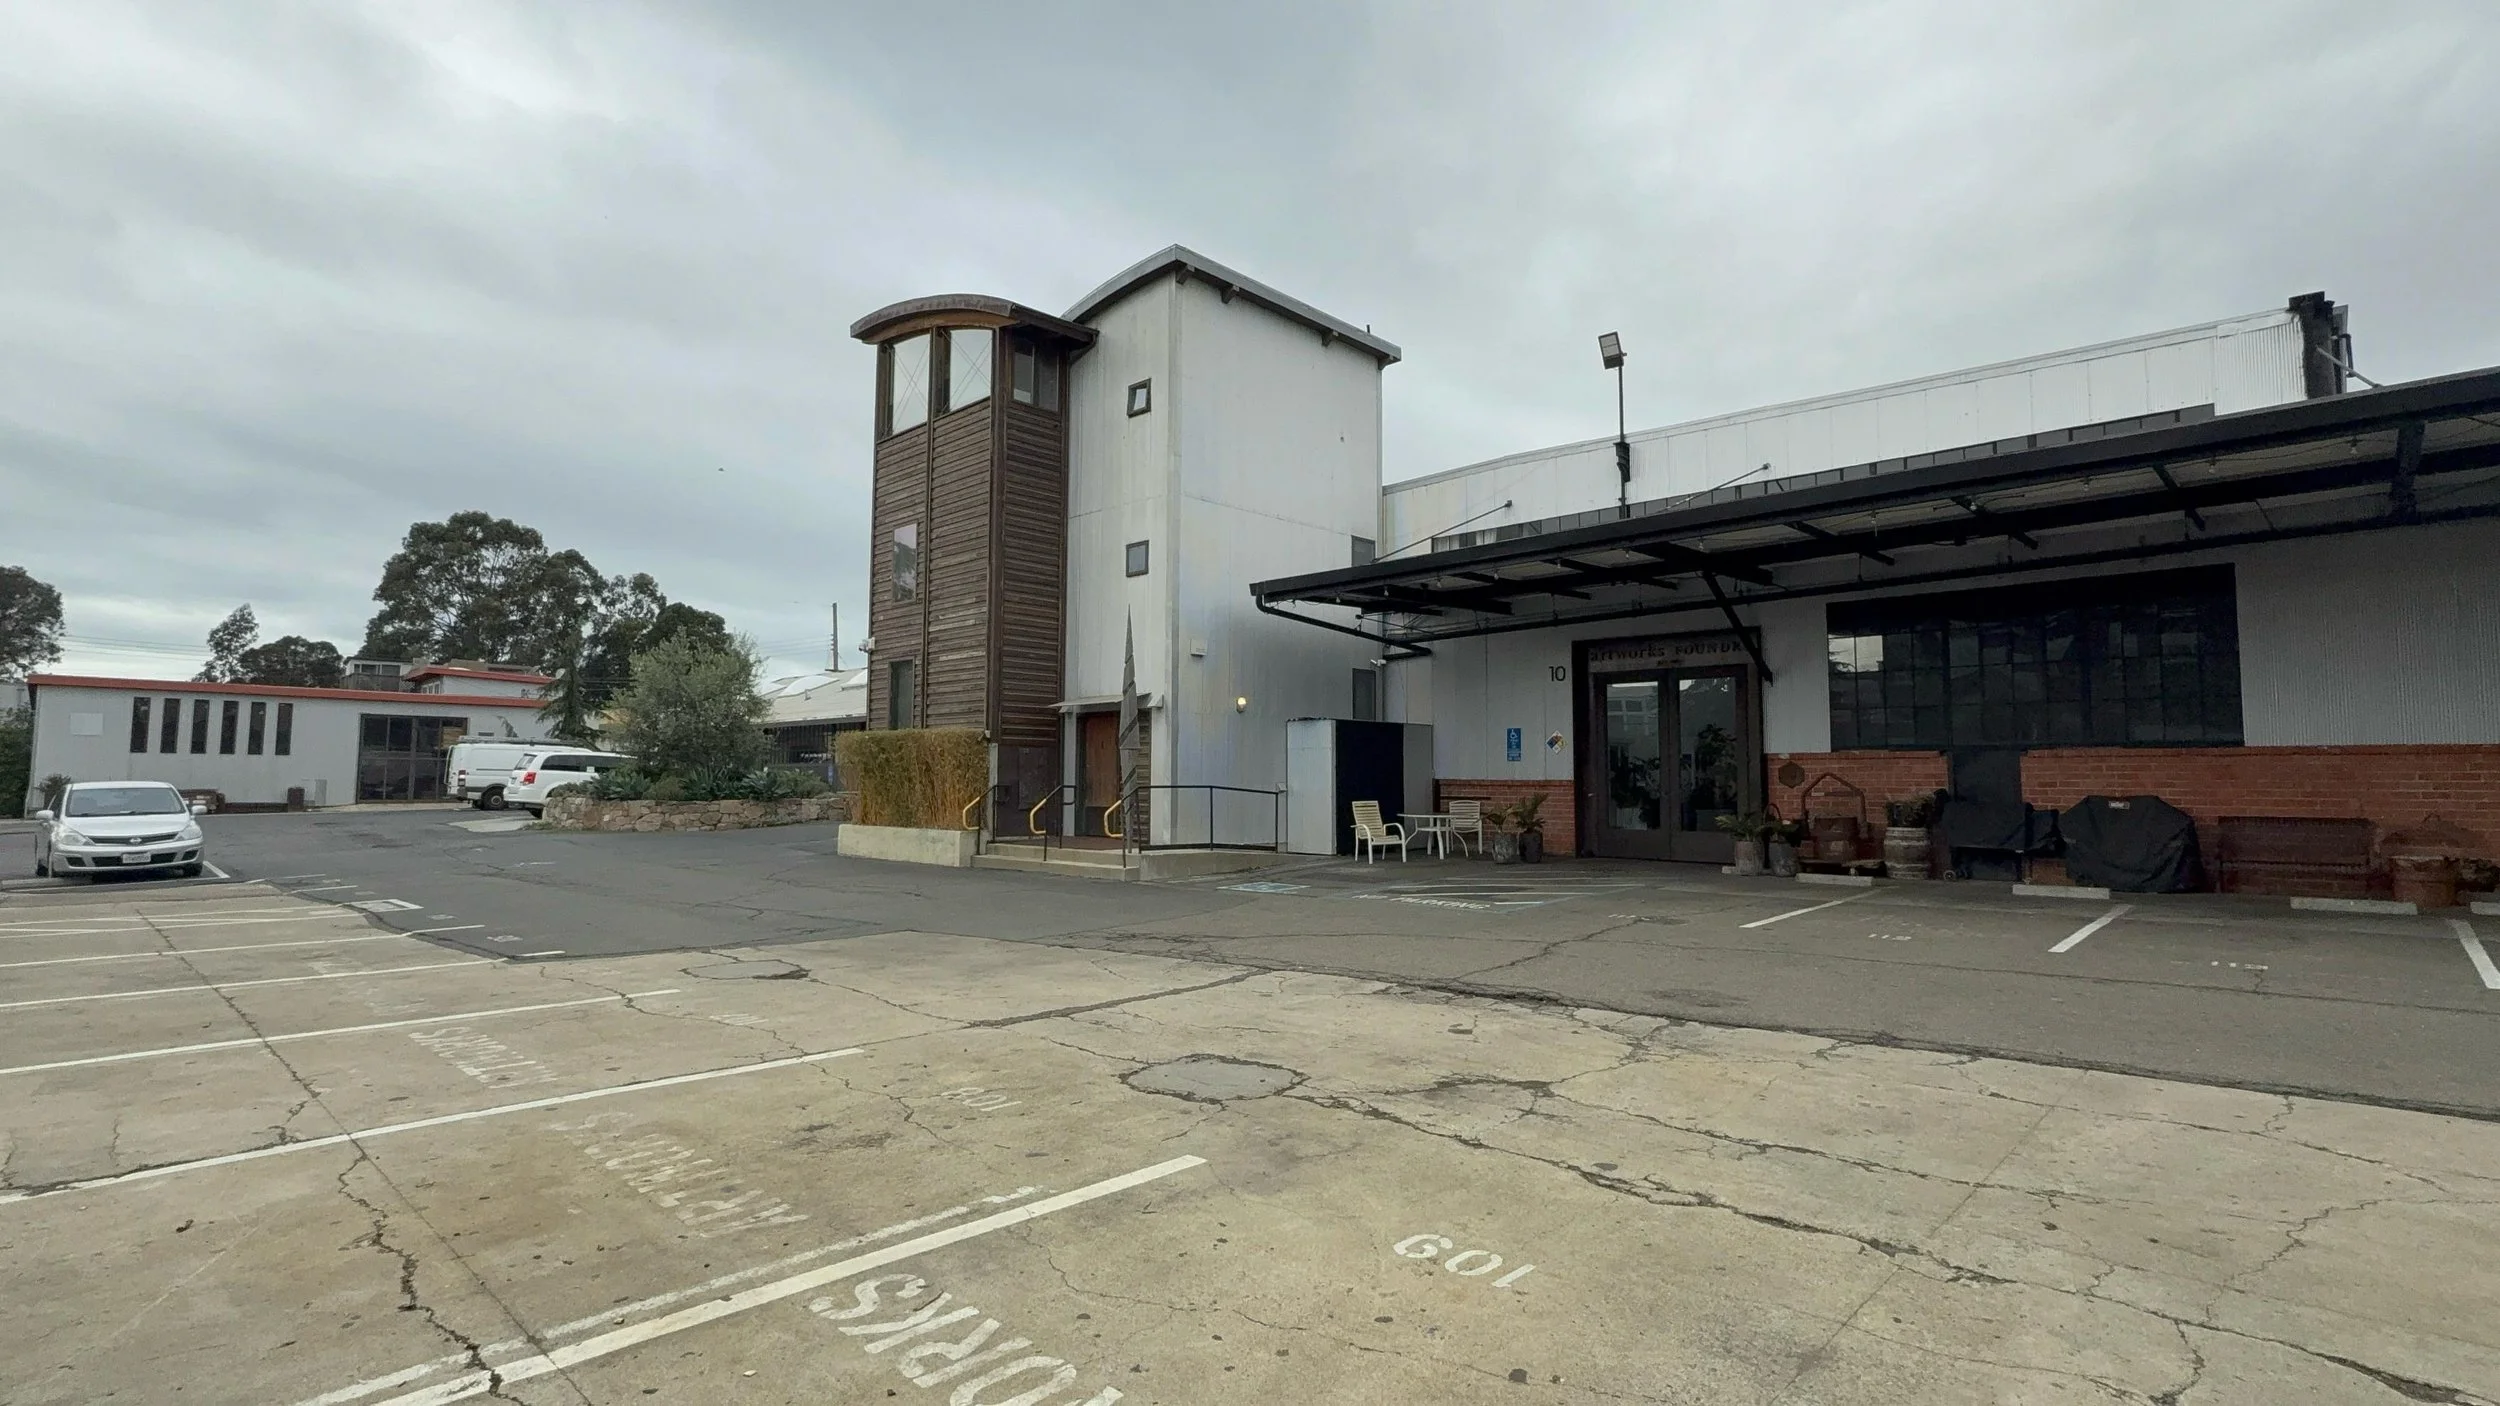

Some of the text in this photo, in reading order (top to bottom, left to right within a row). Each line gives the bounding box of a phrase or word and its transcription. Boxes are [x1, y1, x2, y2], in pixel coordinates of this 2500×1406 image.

[1675, 641, 1746, 657] FOUNDR
[1549, 665, 1566, 682] 10
[1392, 1234, 1537, 1288] 109
[809, 1273, 1125, 1406] ORKS
